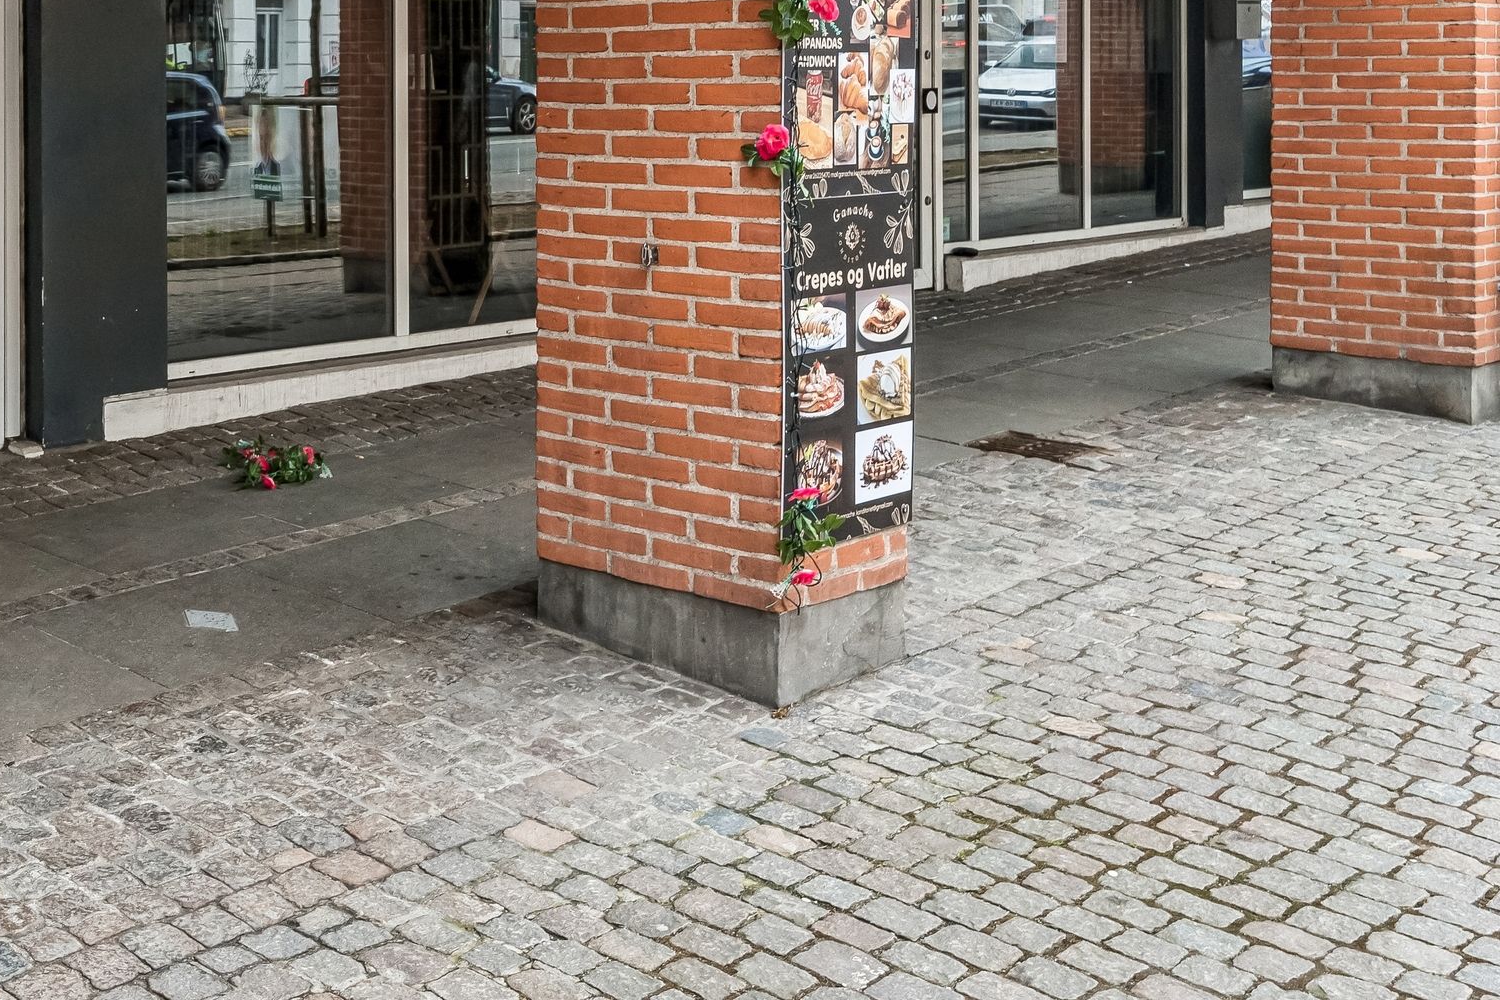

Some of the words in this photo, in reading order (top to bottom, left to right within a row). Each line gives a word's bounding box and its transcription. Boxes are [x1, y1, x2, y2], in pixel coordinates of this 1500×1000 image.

[832, 203, 875, 223] Ganache
[796, 270, 843, 294] Crepes
[847, 267, 864, 289] og
[867, 258, 908, 282] Vafler
